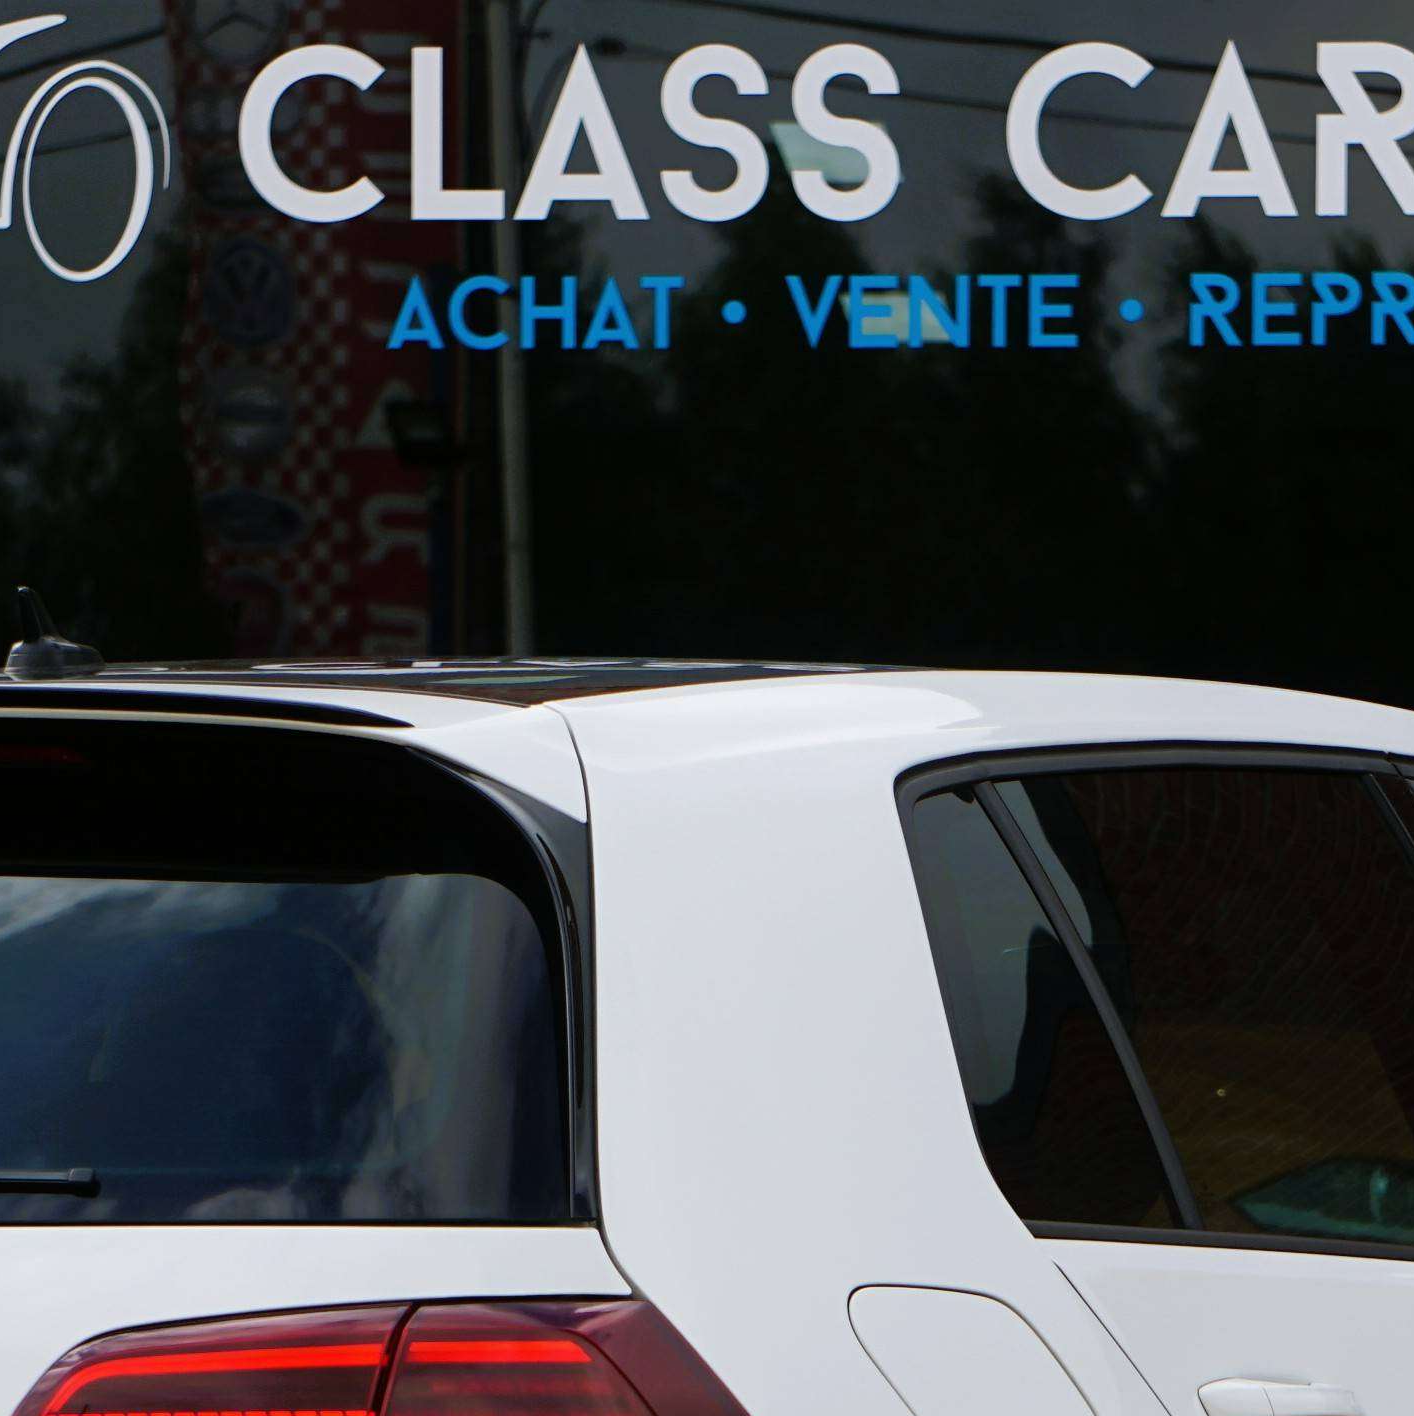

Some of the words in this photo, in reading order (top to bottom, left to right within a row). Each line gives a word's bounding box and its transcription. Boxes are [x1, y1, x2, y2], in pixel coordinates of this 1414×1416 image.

[238, 43, 902, 224] CLASS
[387, 274, 687, 350] ACHAT
[784, 274, 1080, 349] VENTE
